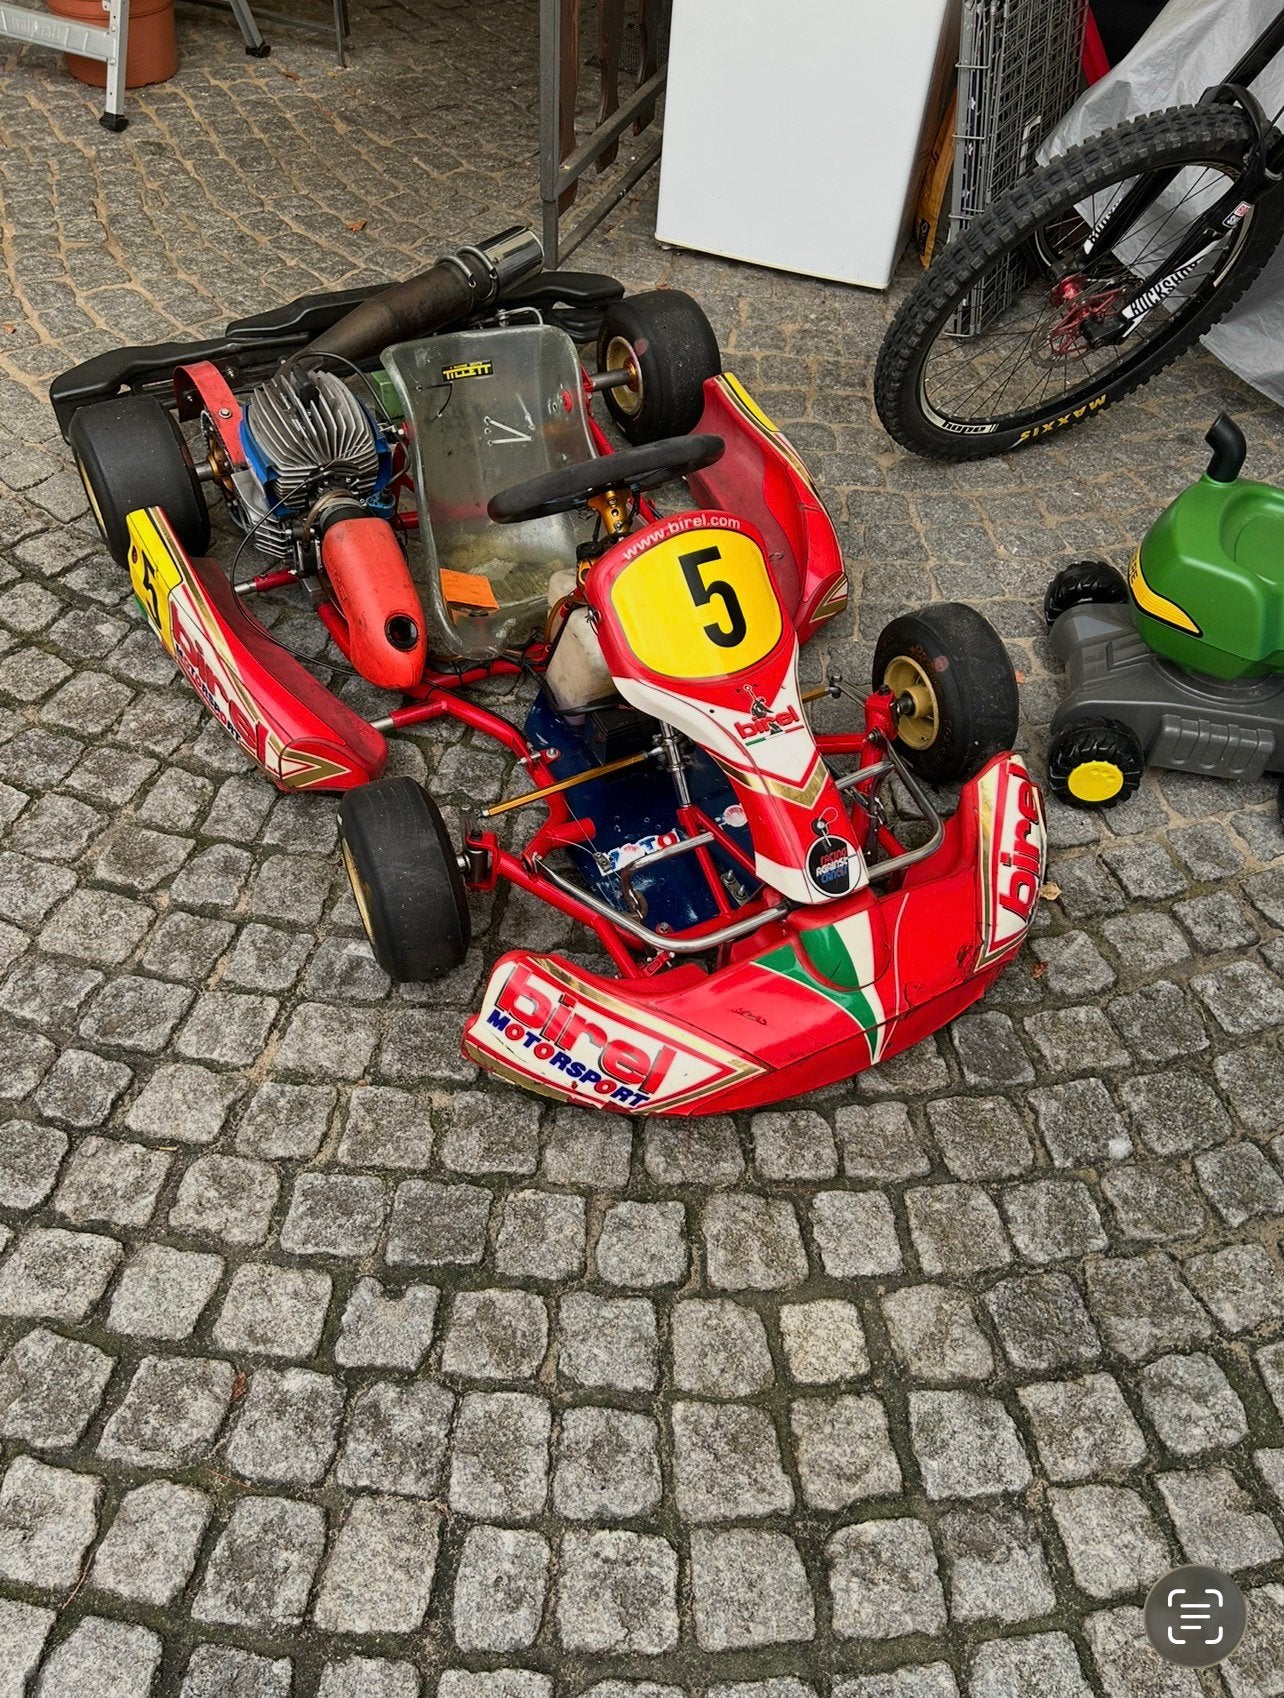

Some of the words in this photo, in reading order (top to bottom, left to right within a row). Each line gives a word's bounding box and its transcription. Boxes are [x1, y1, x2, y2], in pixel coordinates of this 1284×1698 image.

[443, 364, 491, 380] TILLETT
[942, 420, 986, 434] hope
[1020, 394, 1107, 441] MAXXIS
[622, 514, 741, 561] www.birel.com
[142, 549, 162, 631] 5
[678, 545, 747, 648] 5
[170, 600, 270, 768] birel
[734, 704, 801, 739] birel
[999, 762, 1041, 923] birel
[487, 1010, 650, 1107] MOTORSPORT
[494, 963, 677, 1094] birel
